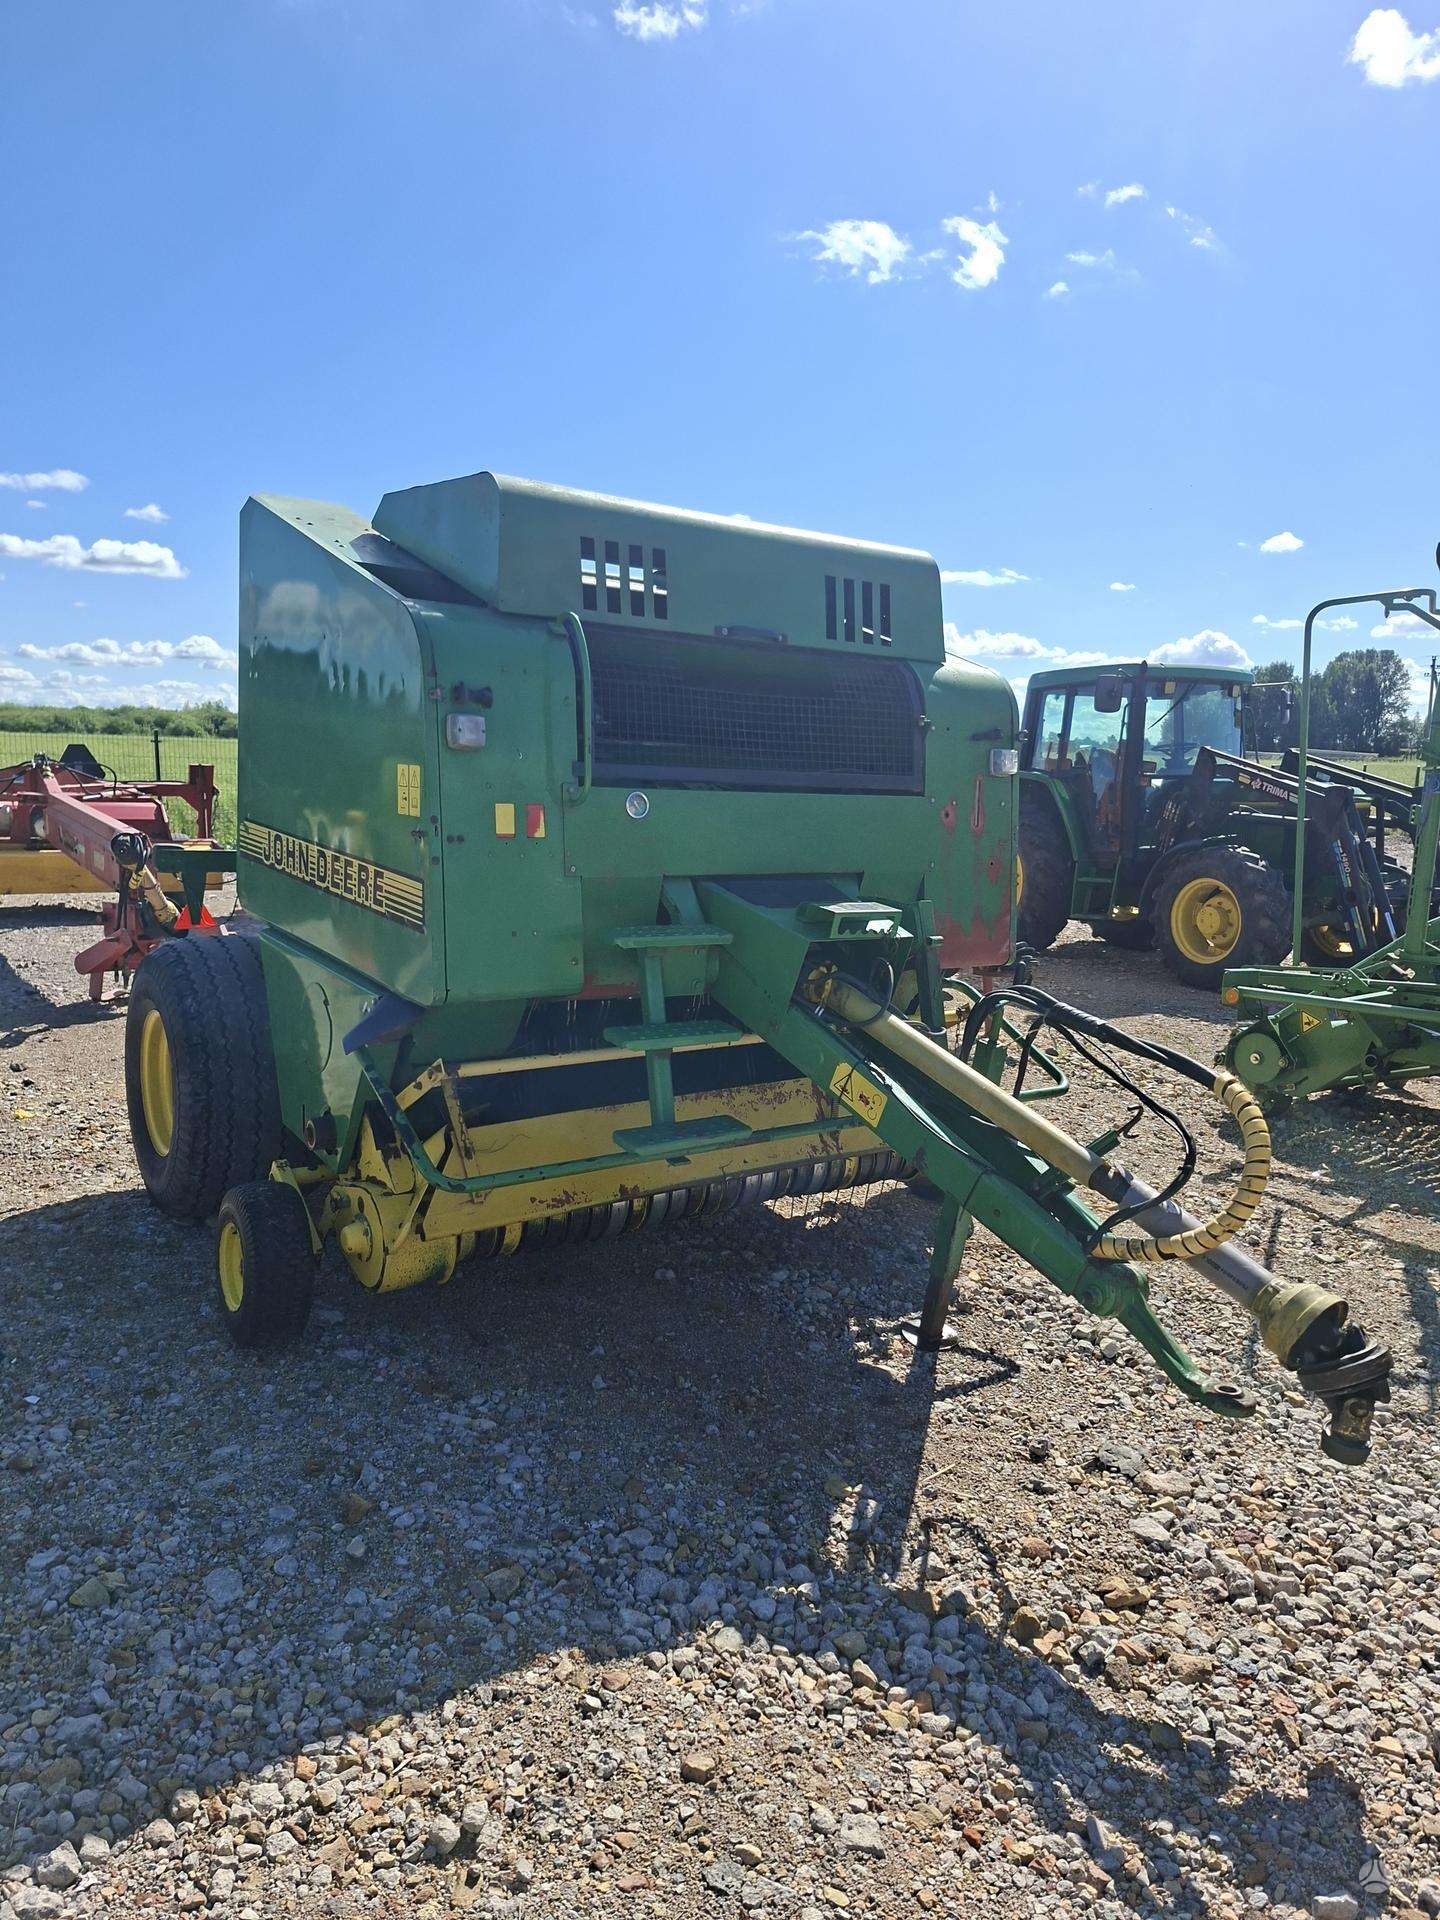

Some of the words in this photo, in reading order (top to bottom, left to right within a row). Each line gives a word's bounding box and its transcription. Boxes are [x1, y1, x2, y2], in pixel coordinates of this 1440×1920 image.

[1262, 782, 1288, 800] TRIMA
[262, 830, 310, 880] JOHN
[316, 849, 386, 911] DEERE
